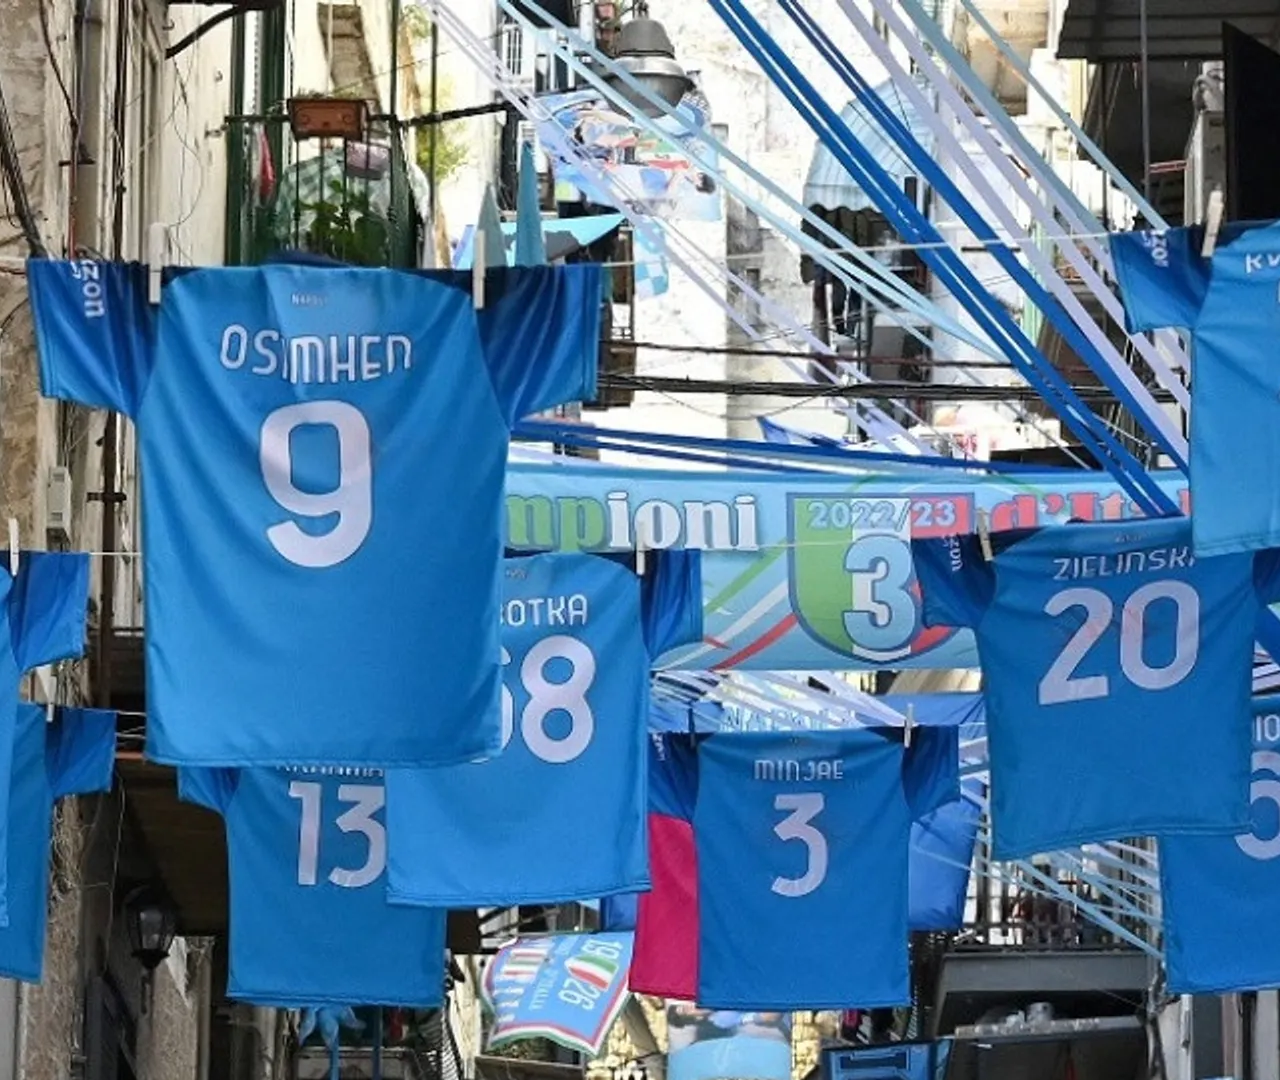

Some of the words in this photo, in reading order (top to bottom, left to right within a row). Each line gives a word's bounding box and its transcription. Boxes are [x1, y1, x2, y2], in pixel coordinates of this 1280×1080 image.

[259, 400, 374, 569] 9
[807, 498, 957, 534] 2022/23
[500, 594, 589, 627] OTKA
[842, 533, 926, 653] 3
[1038, 579, 1200, 706] 20
[286, 781, 387, 888] 13
[770, 791, 829, 898] 3
